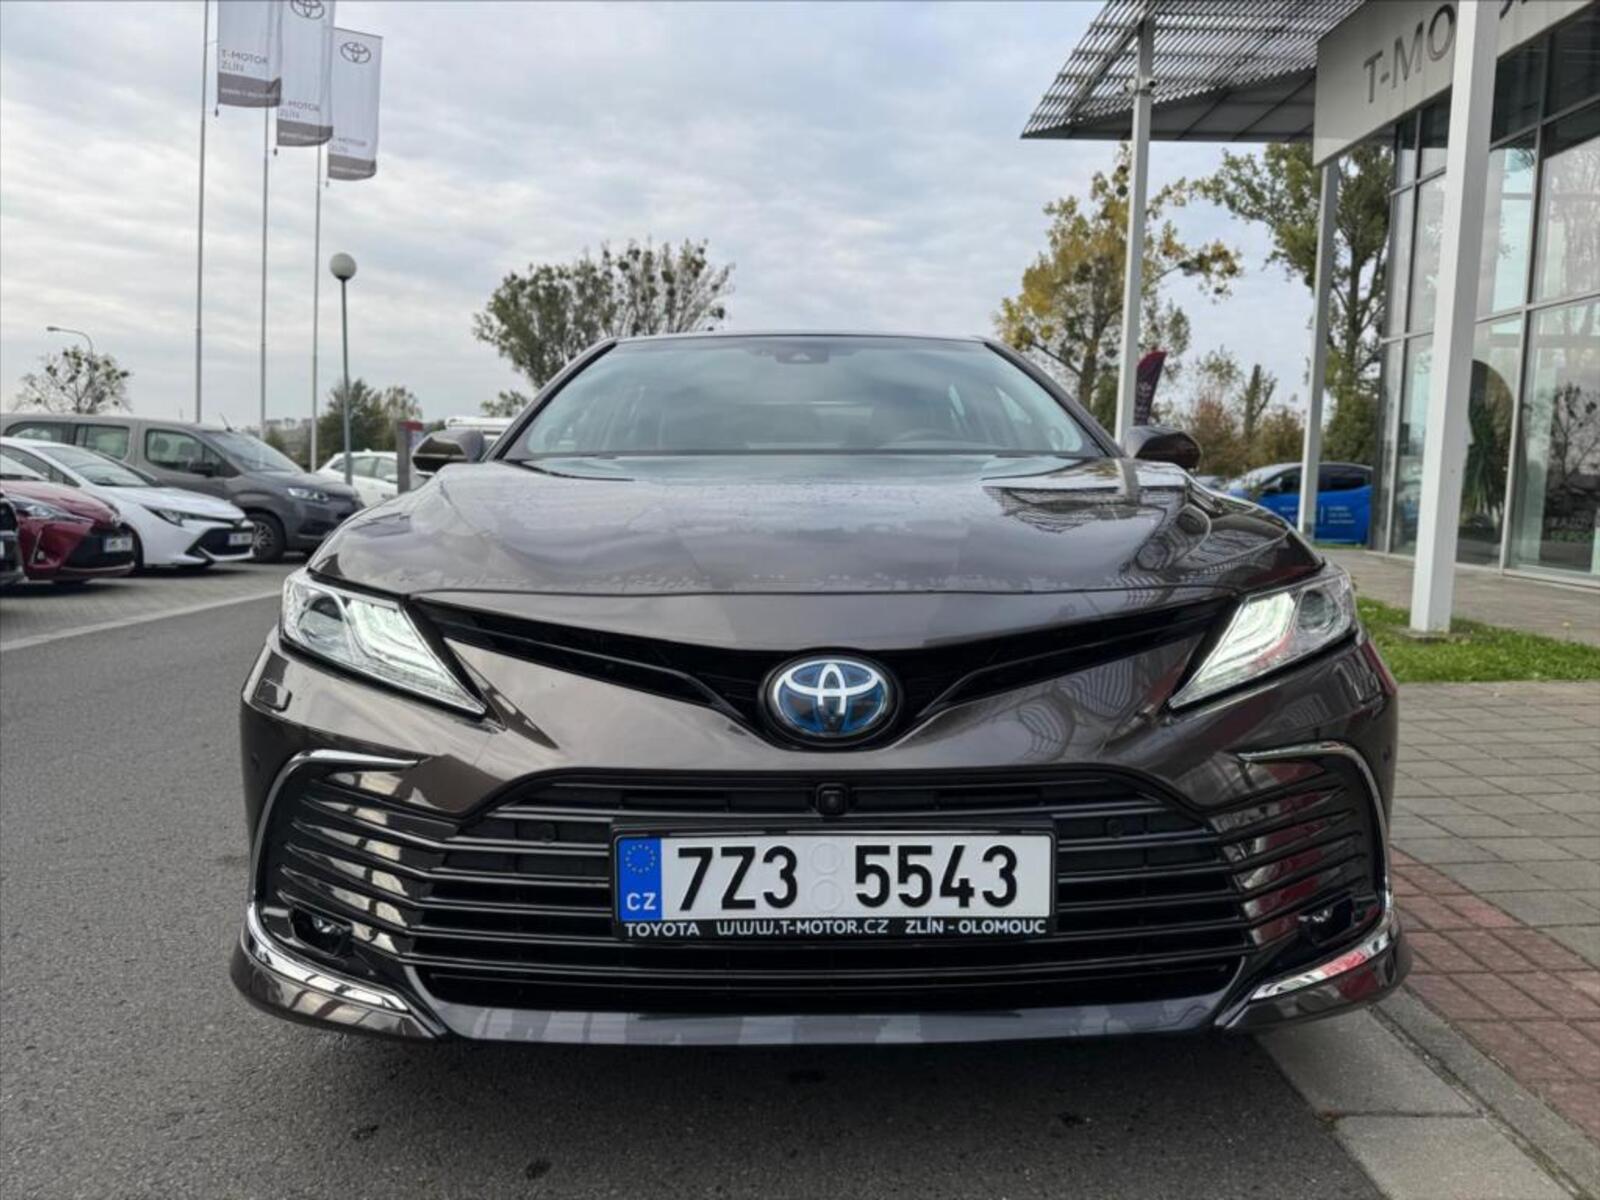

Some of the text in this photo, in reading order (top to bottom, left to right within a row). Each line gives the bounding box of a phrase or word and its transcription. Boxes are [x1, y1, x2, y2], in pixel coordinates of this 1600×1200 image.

[678, 844, 1018, 911] 7Z3 5543
[626, 892, 656, 911] CZ
[625, 922, 700, 937] TOYOTA
[716, 919, 888, 935] WWW.T-MOTOR.CZ
[905, 916, 945, 934] ZLÍN
[958, 919, 1047, 935] OLOMOUC
